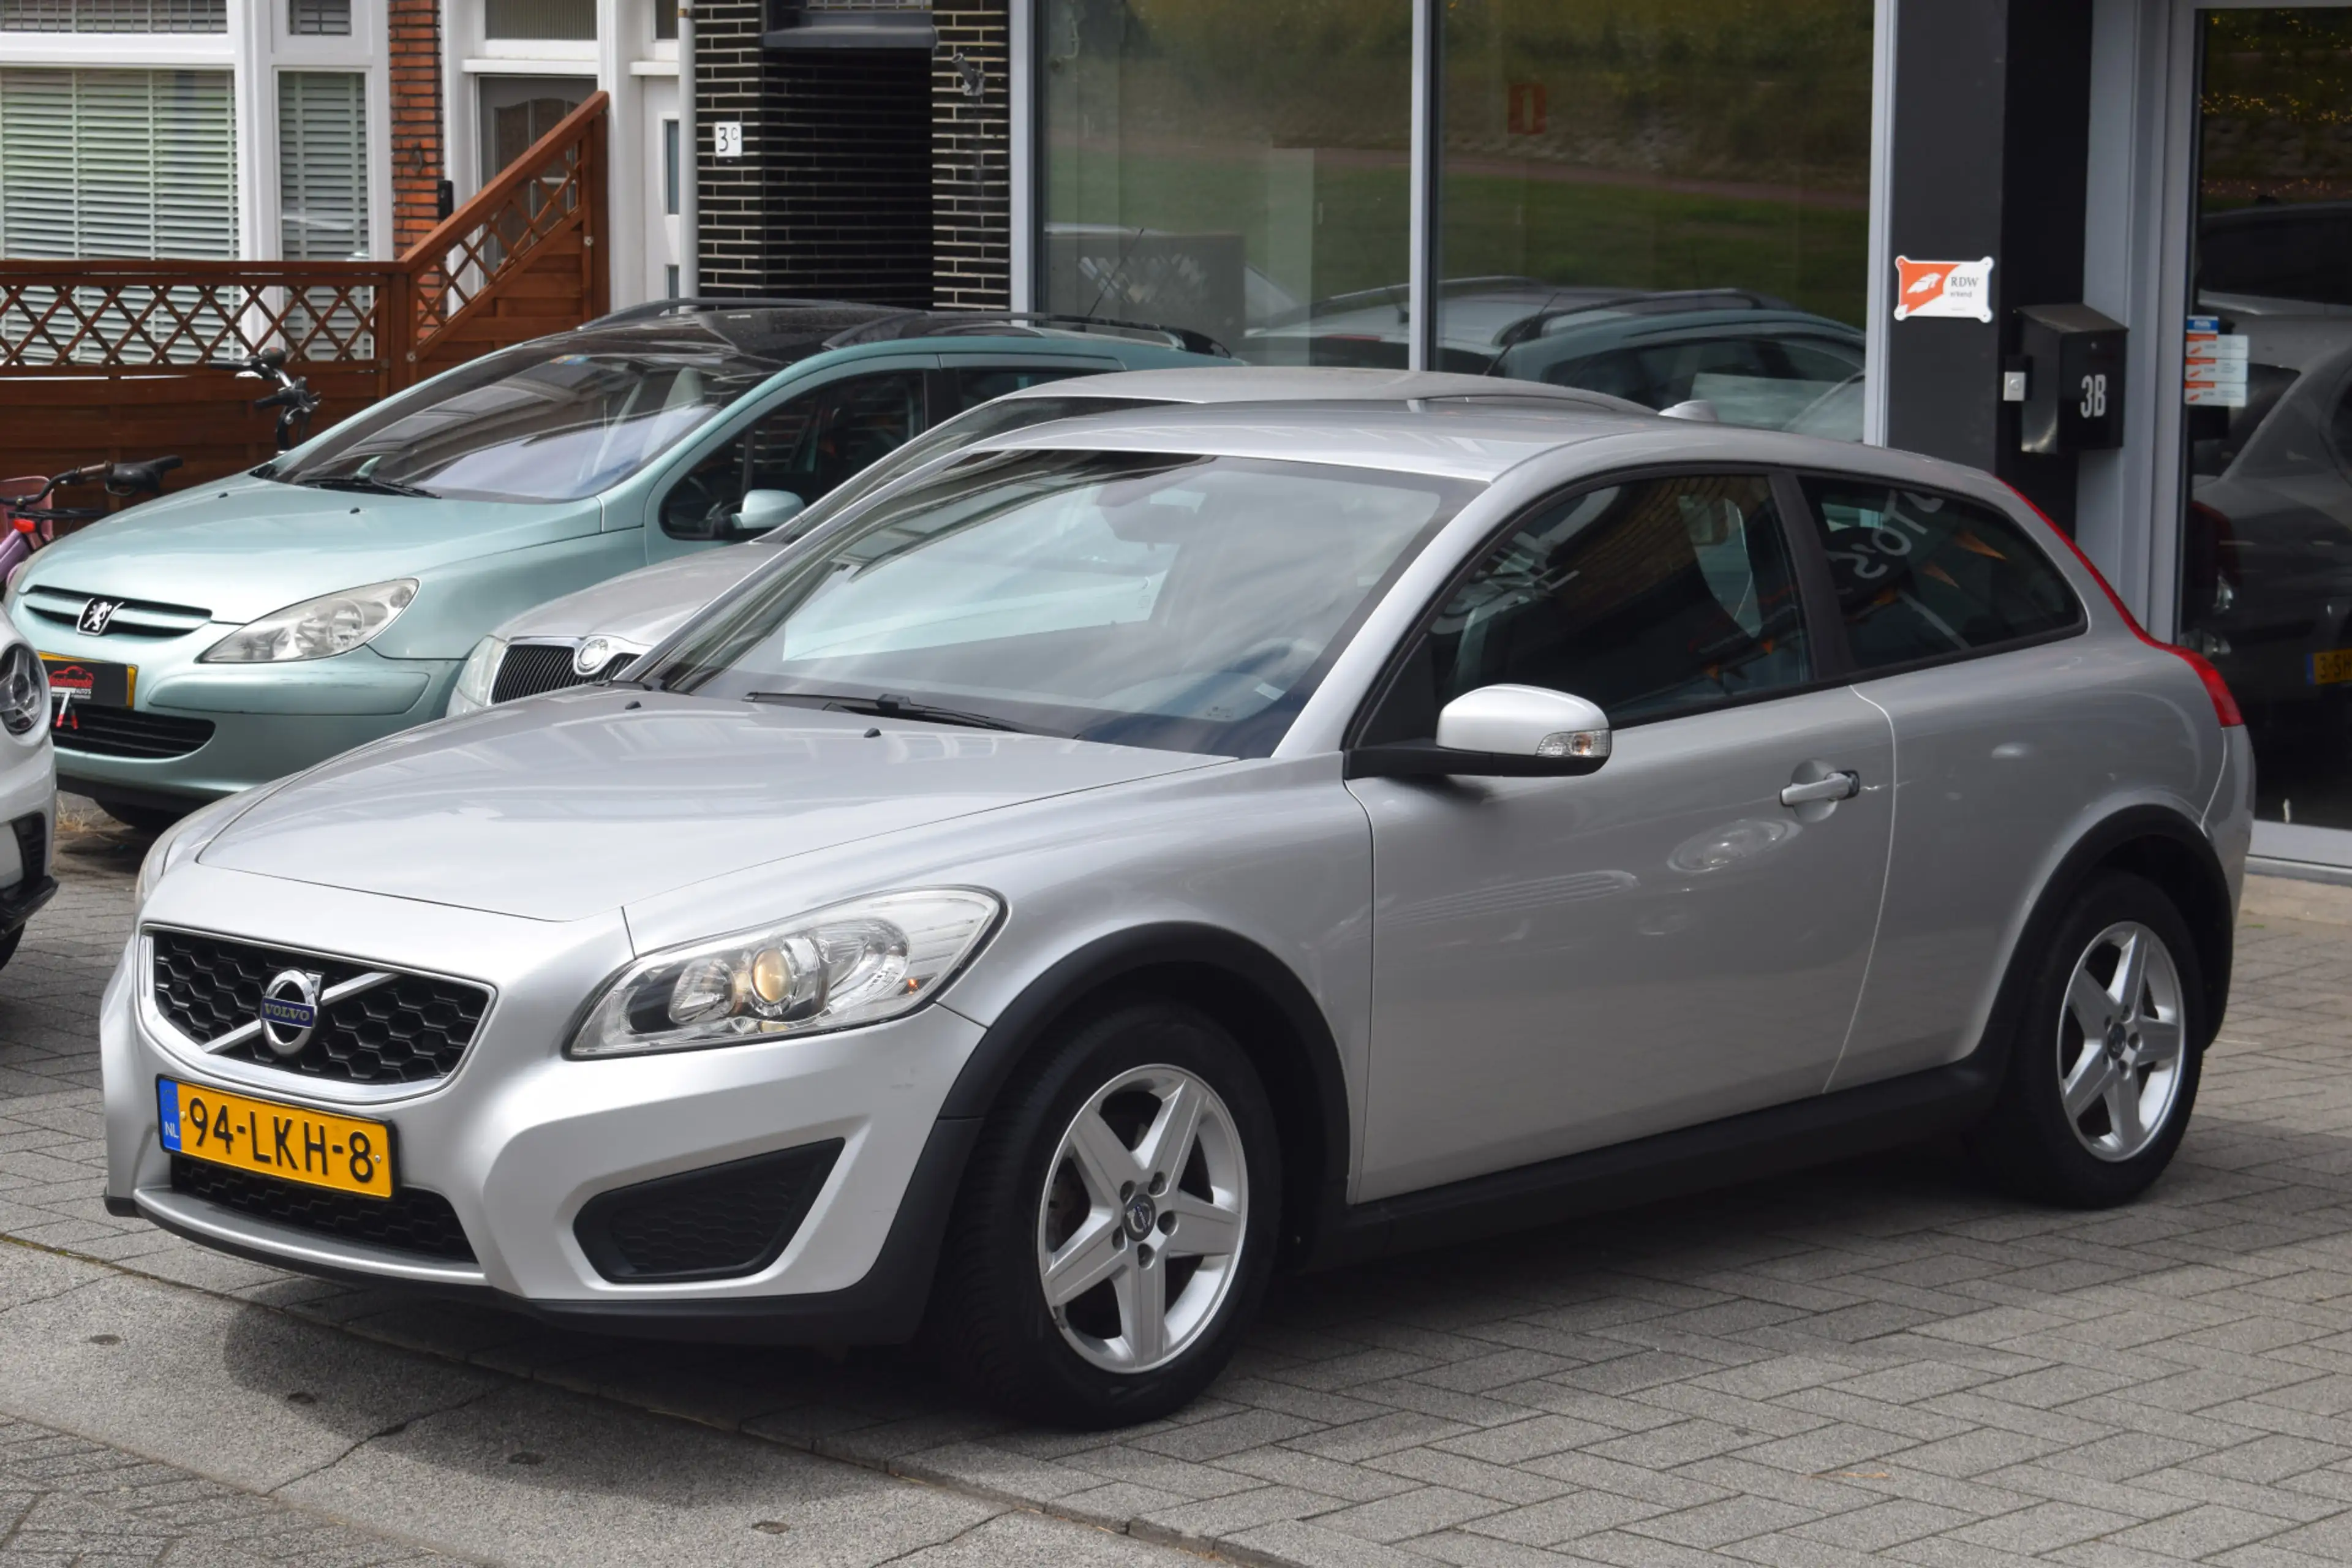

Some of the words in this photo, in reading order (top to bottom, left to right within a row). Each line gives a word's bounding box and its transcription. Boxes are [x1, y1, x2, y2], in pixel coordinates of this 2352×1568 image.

[1950, 276, 1980, 288] RDW
[2080, 374, 2106, 418] 3B
[264, 1003, 311, 1022] VOLVO
[165, 1120, 179, 1139] NL
[189, 1096, 374, 1183] 94-LKH-8
